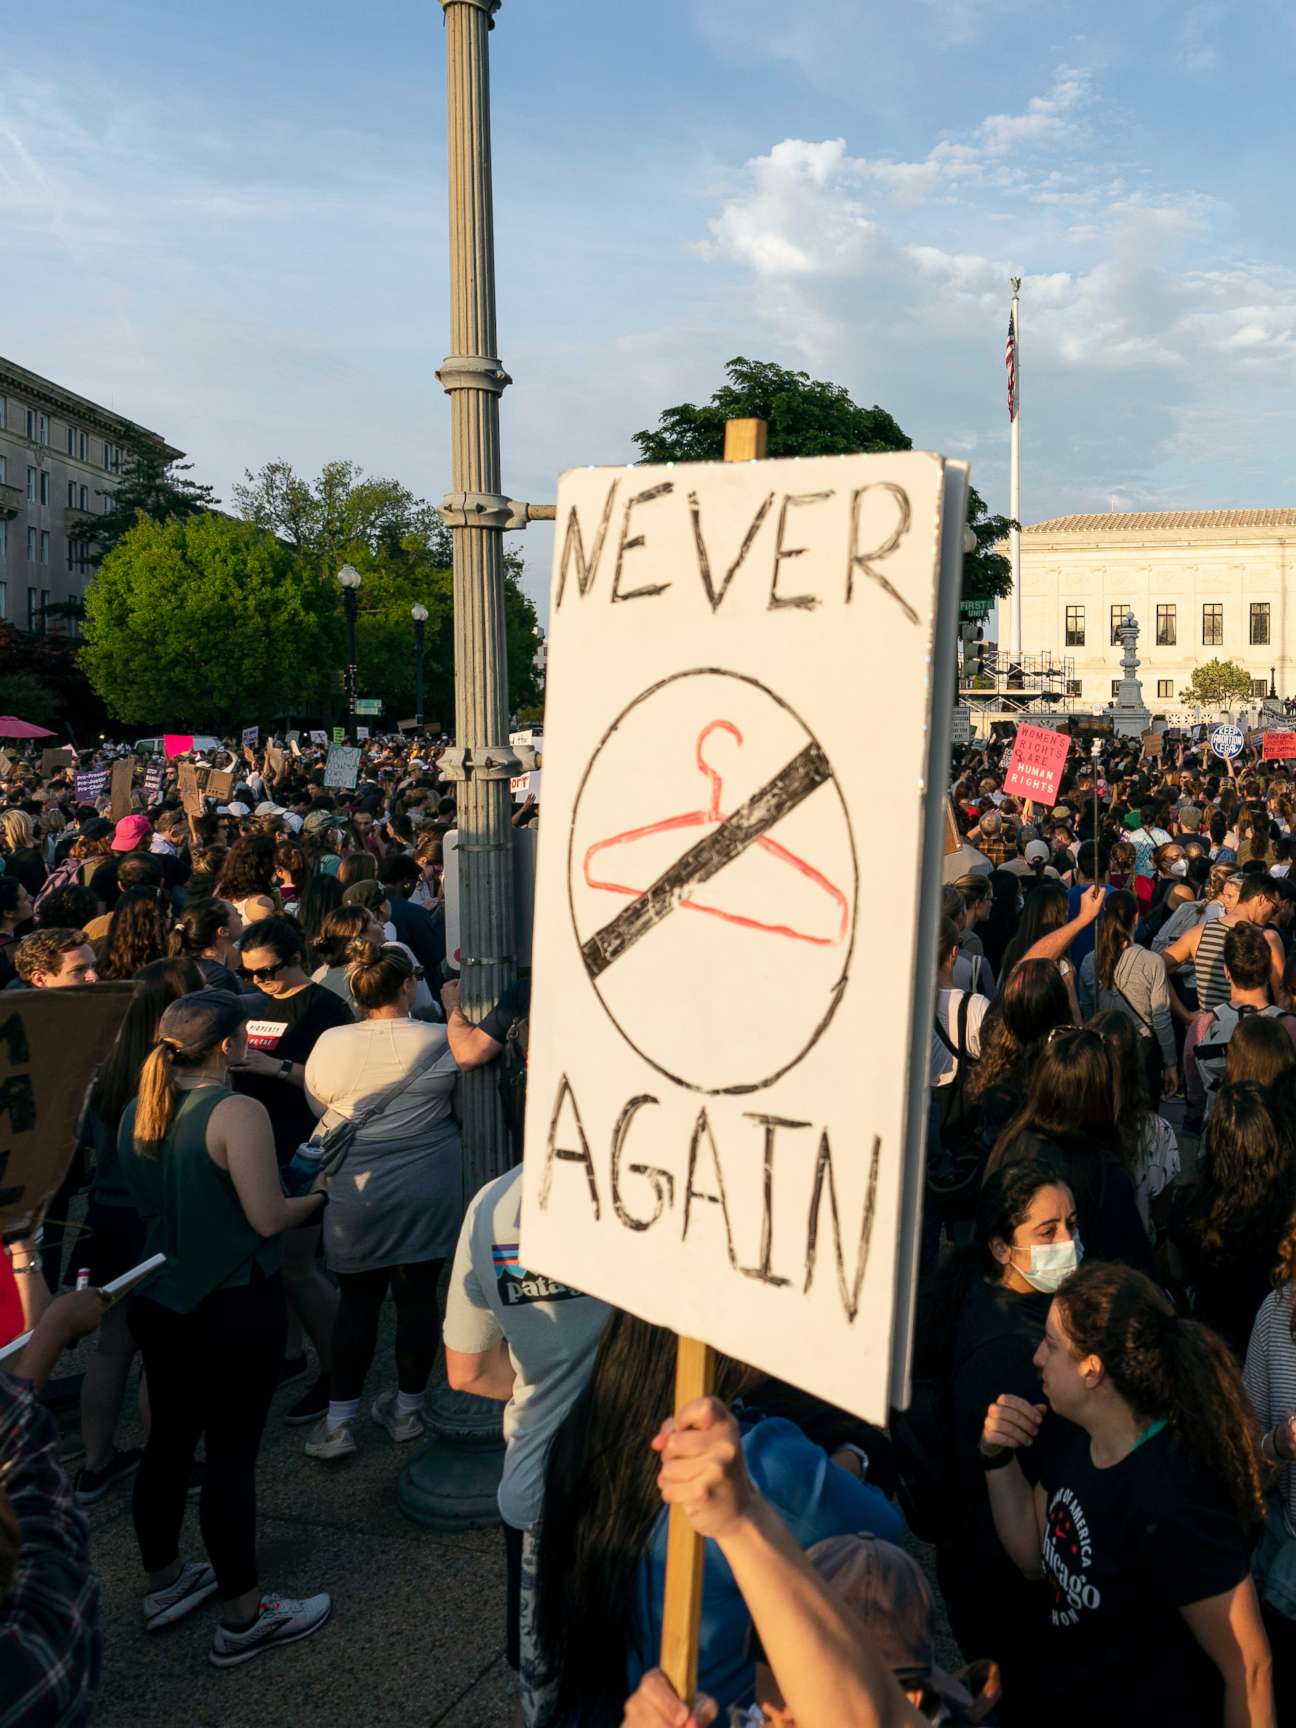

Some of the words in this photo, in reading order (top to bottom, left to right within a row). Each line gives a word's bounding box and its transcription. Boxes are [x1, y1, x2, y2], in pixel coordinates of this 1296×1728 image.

[556, 478, 921, 625] NEVER
[960, 601, 986, 609] FIRST
[1022, 727, 1065, 748] WOMEN'S
[1020, 741, 1062, 759] RIGHTS
[1027, 754, 1048, 766] ARE
[1018, 763, 1053, 780] HUMAN
[1010, 773, 1054, 793] RIGHTS
[537, 1071, 882, 1323] AGAIN
[1069, 1498, 1093, 1568] AMERICA
[1042, 1520, 1101, 1610] hicago
